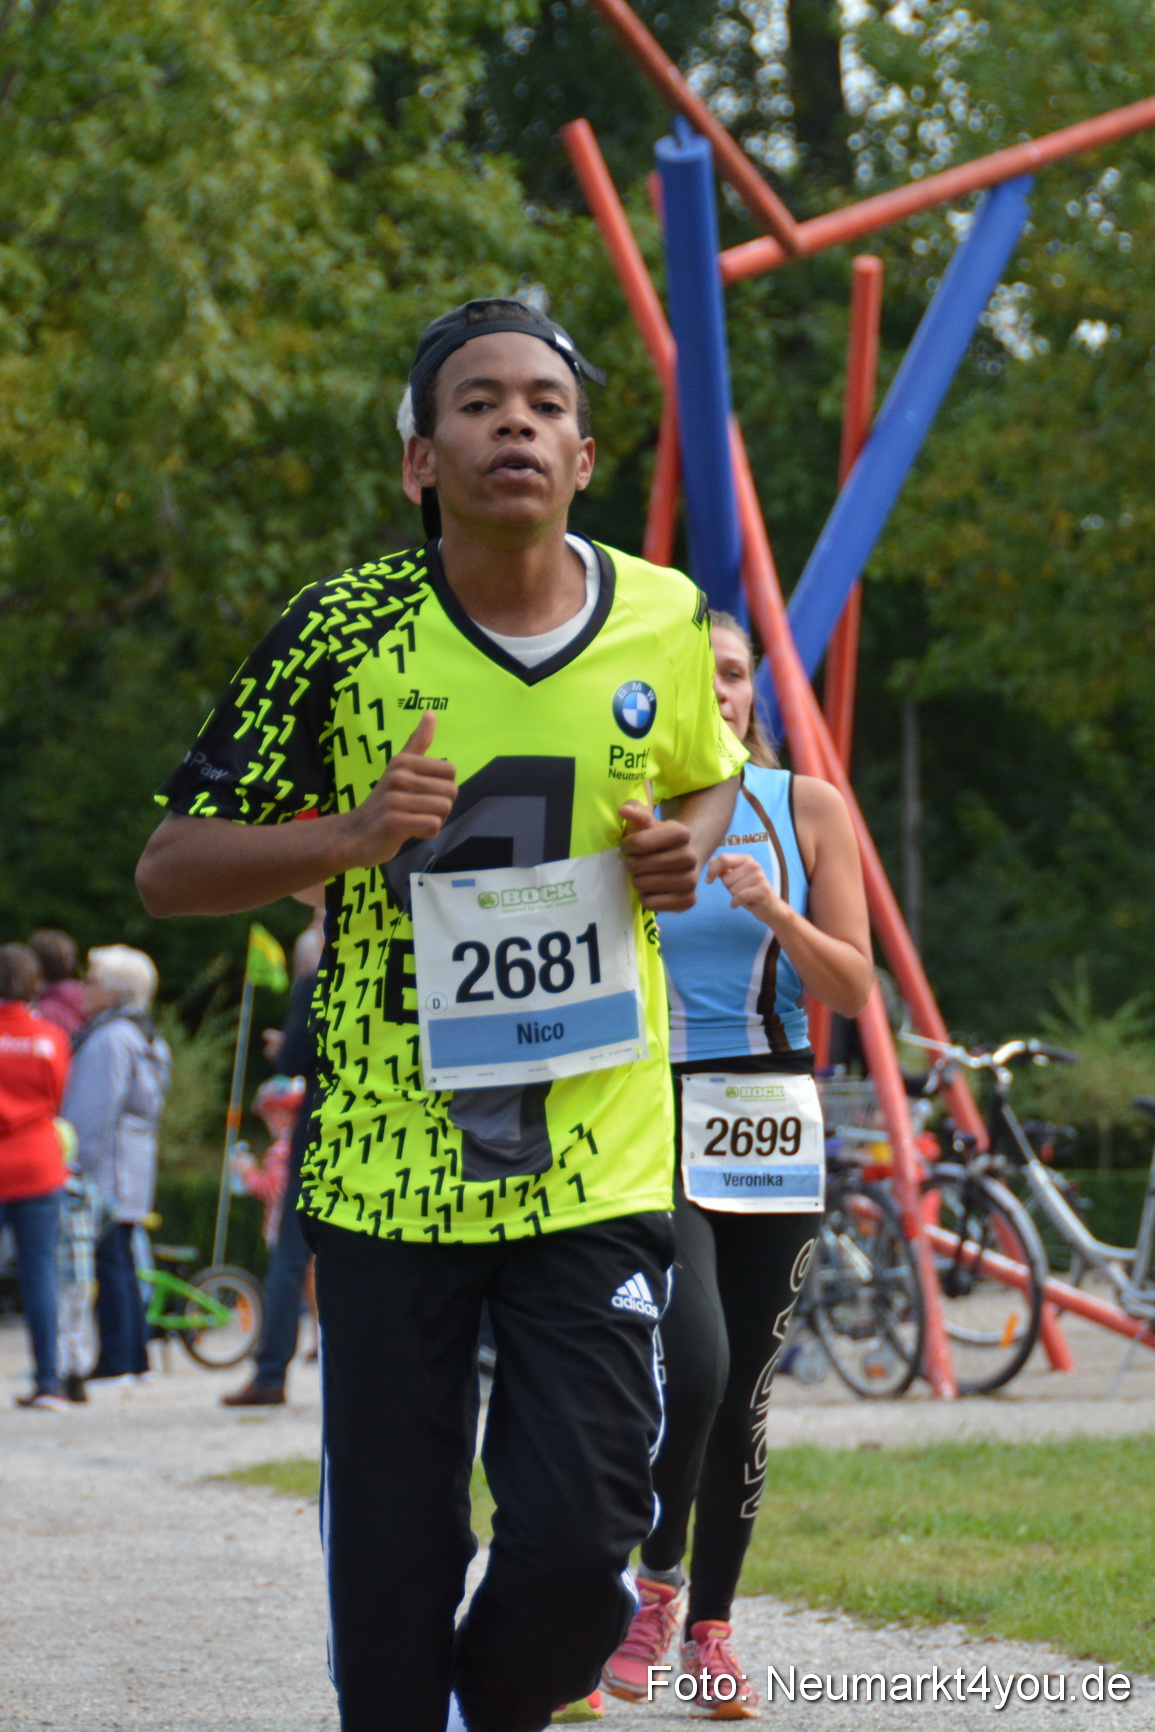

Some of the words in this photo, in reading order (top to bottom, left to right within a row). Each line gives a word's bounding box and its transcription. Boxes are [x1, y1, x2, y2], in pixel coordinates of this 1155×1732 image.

[617, 682, 656, 703] BMW
[501, 880, 577, 907] BOCK
[452, 923, 602, 1004] 2681
[432, 998, 441, 1009] D
[516, 1022, 565, 1045] Nico
[740, 1086, 785, 1098] BOCK
[703, 1116, 802, 1157] 2699
[723, 1172, 783, 1187] Veronika
[611, 1295, 659, 1319] adidas
